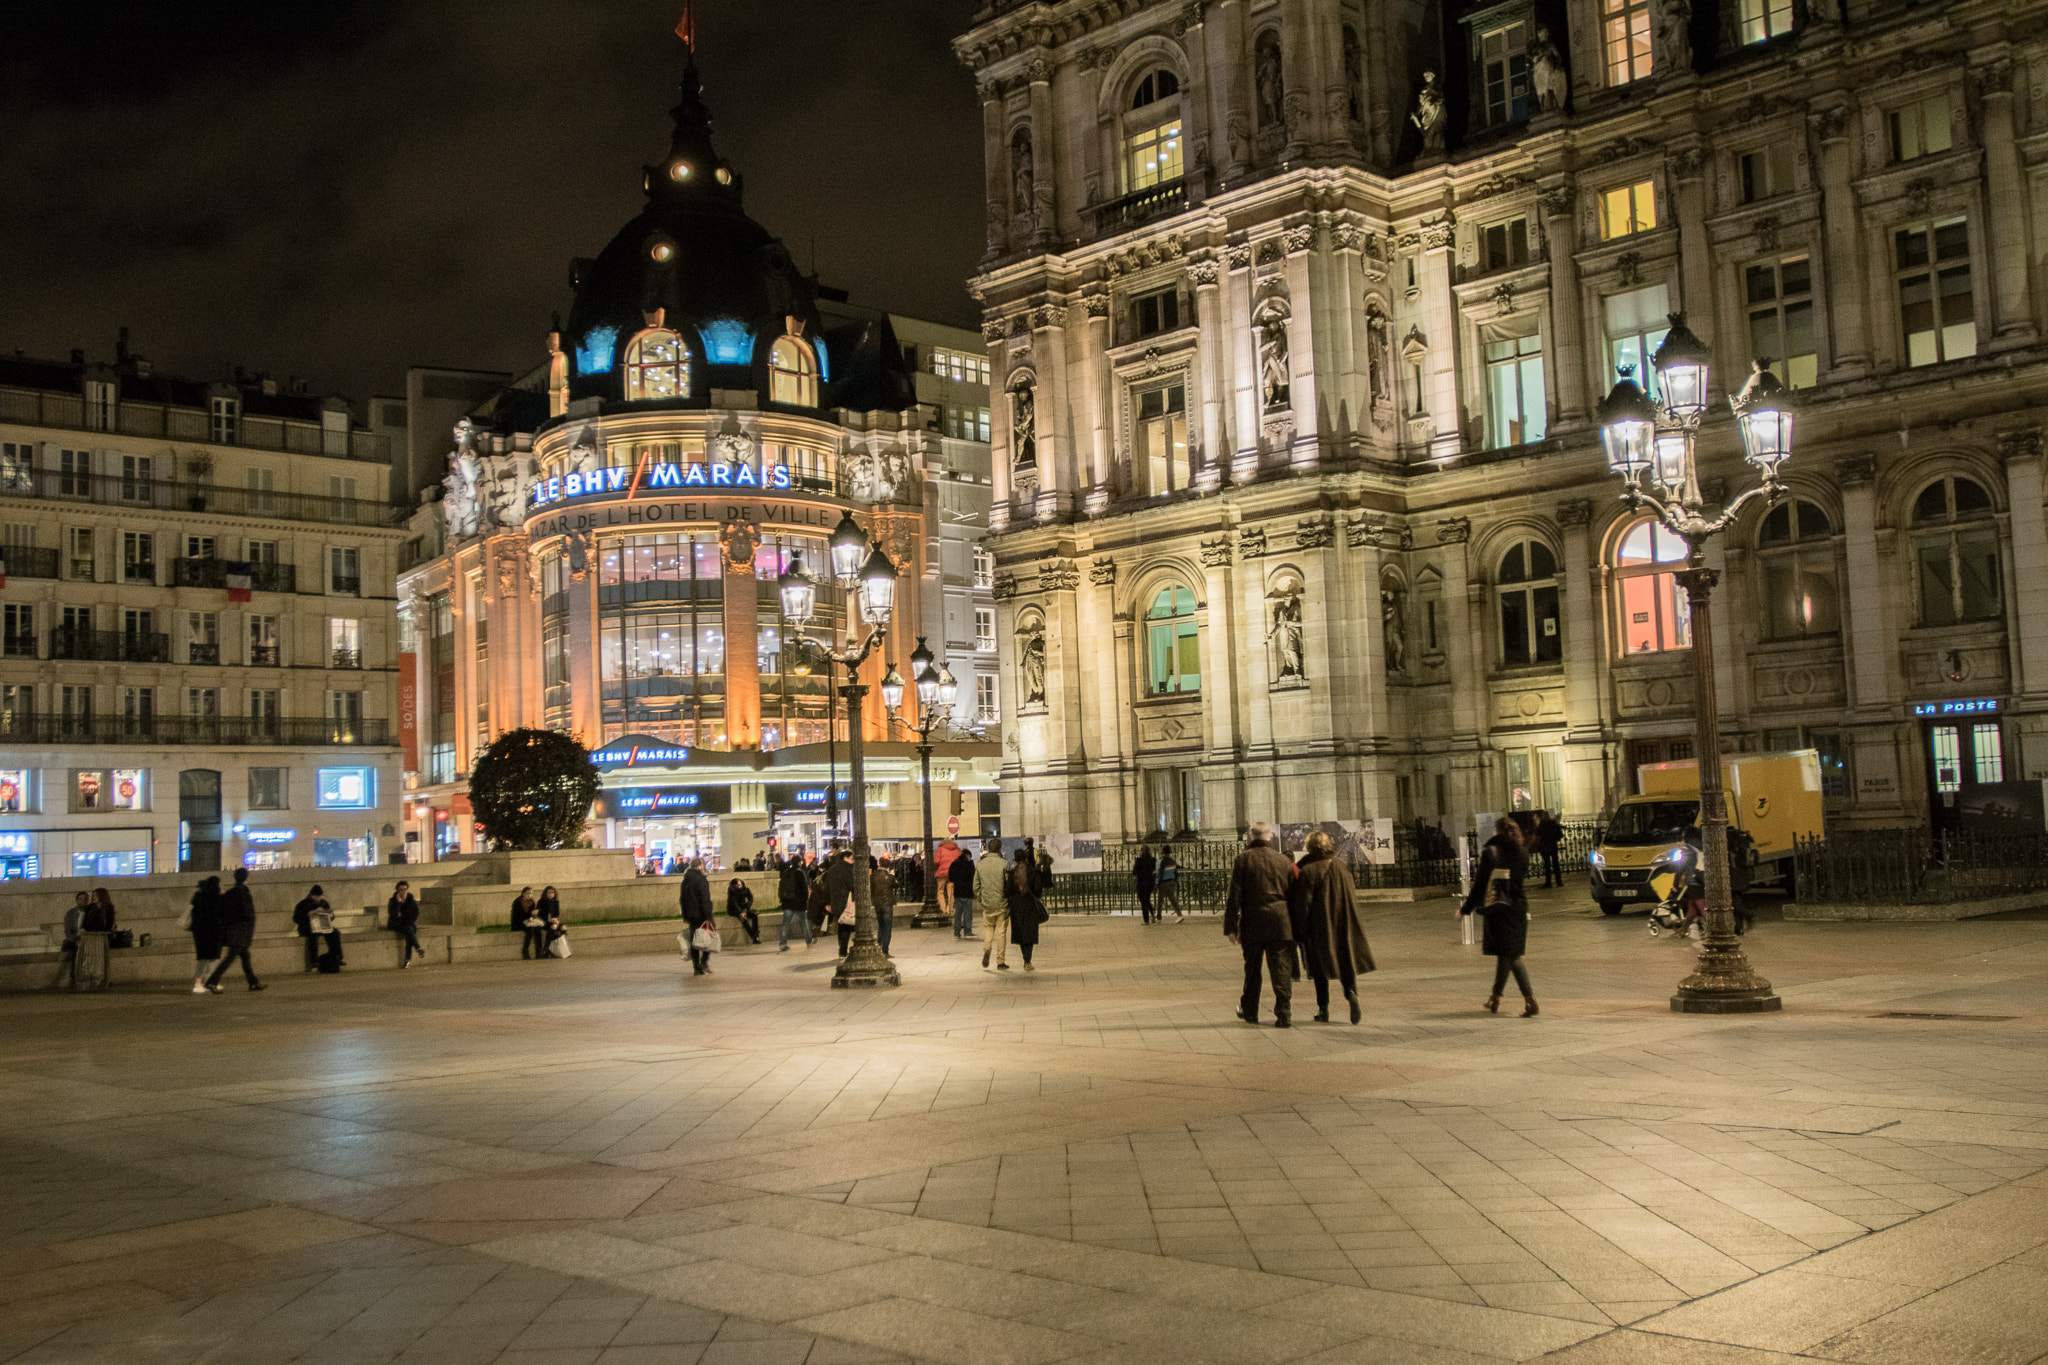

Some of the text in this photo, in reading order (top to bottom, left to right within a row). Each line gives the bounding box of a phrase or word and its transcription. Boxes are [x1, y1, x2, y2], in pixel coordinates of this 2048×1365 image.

[535, 463, 791, 503] LE BHV MARAIS
[577, 513, 597, 529] DE
[608, 502, 714, 524] L'HOTEL
[727, 505, 751, 520] DE
[762, 504, 828, 526] VILLE
[1915, 700, 1997, 714] LA POSTE
[592, 753, 605, 762] LE
[636, 750, 686, 760] MARAIS
[621, 798, 632, 806] LE
[657, 796, 696, 804] MARAIS
